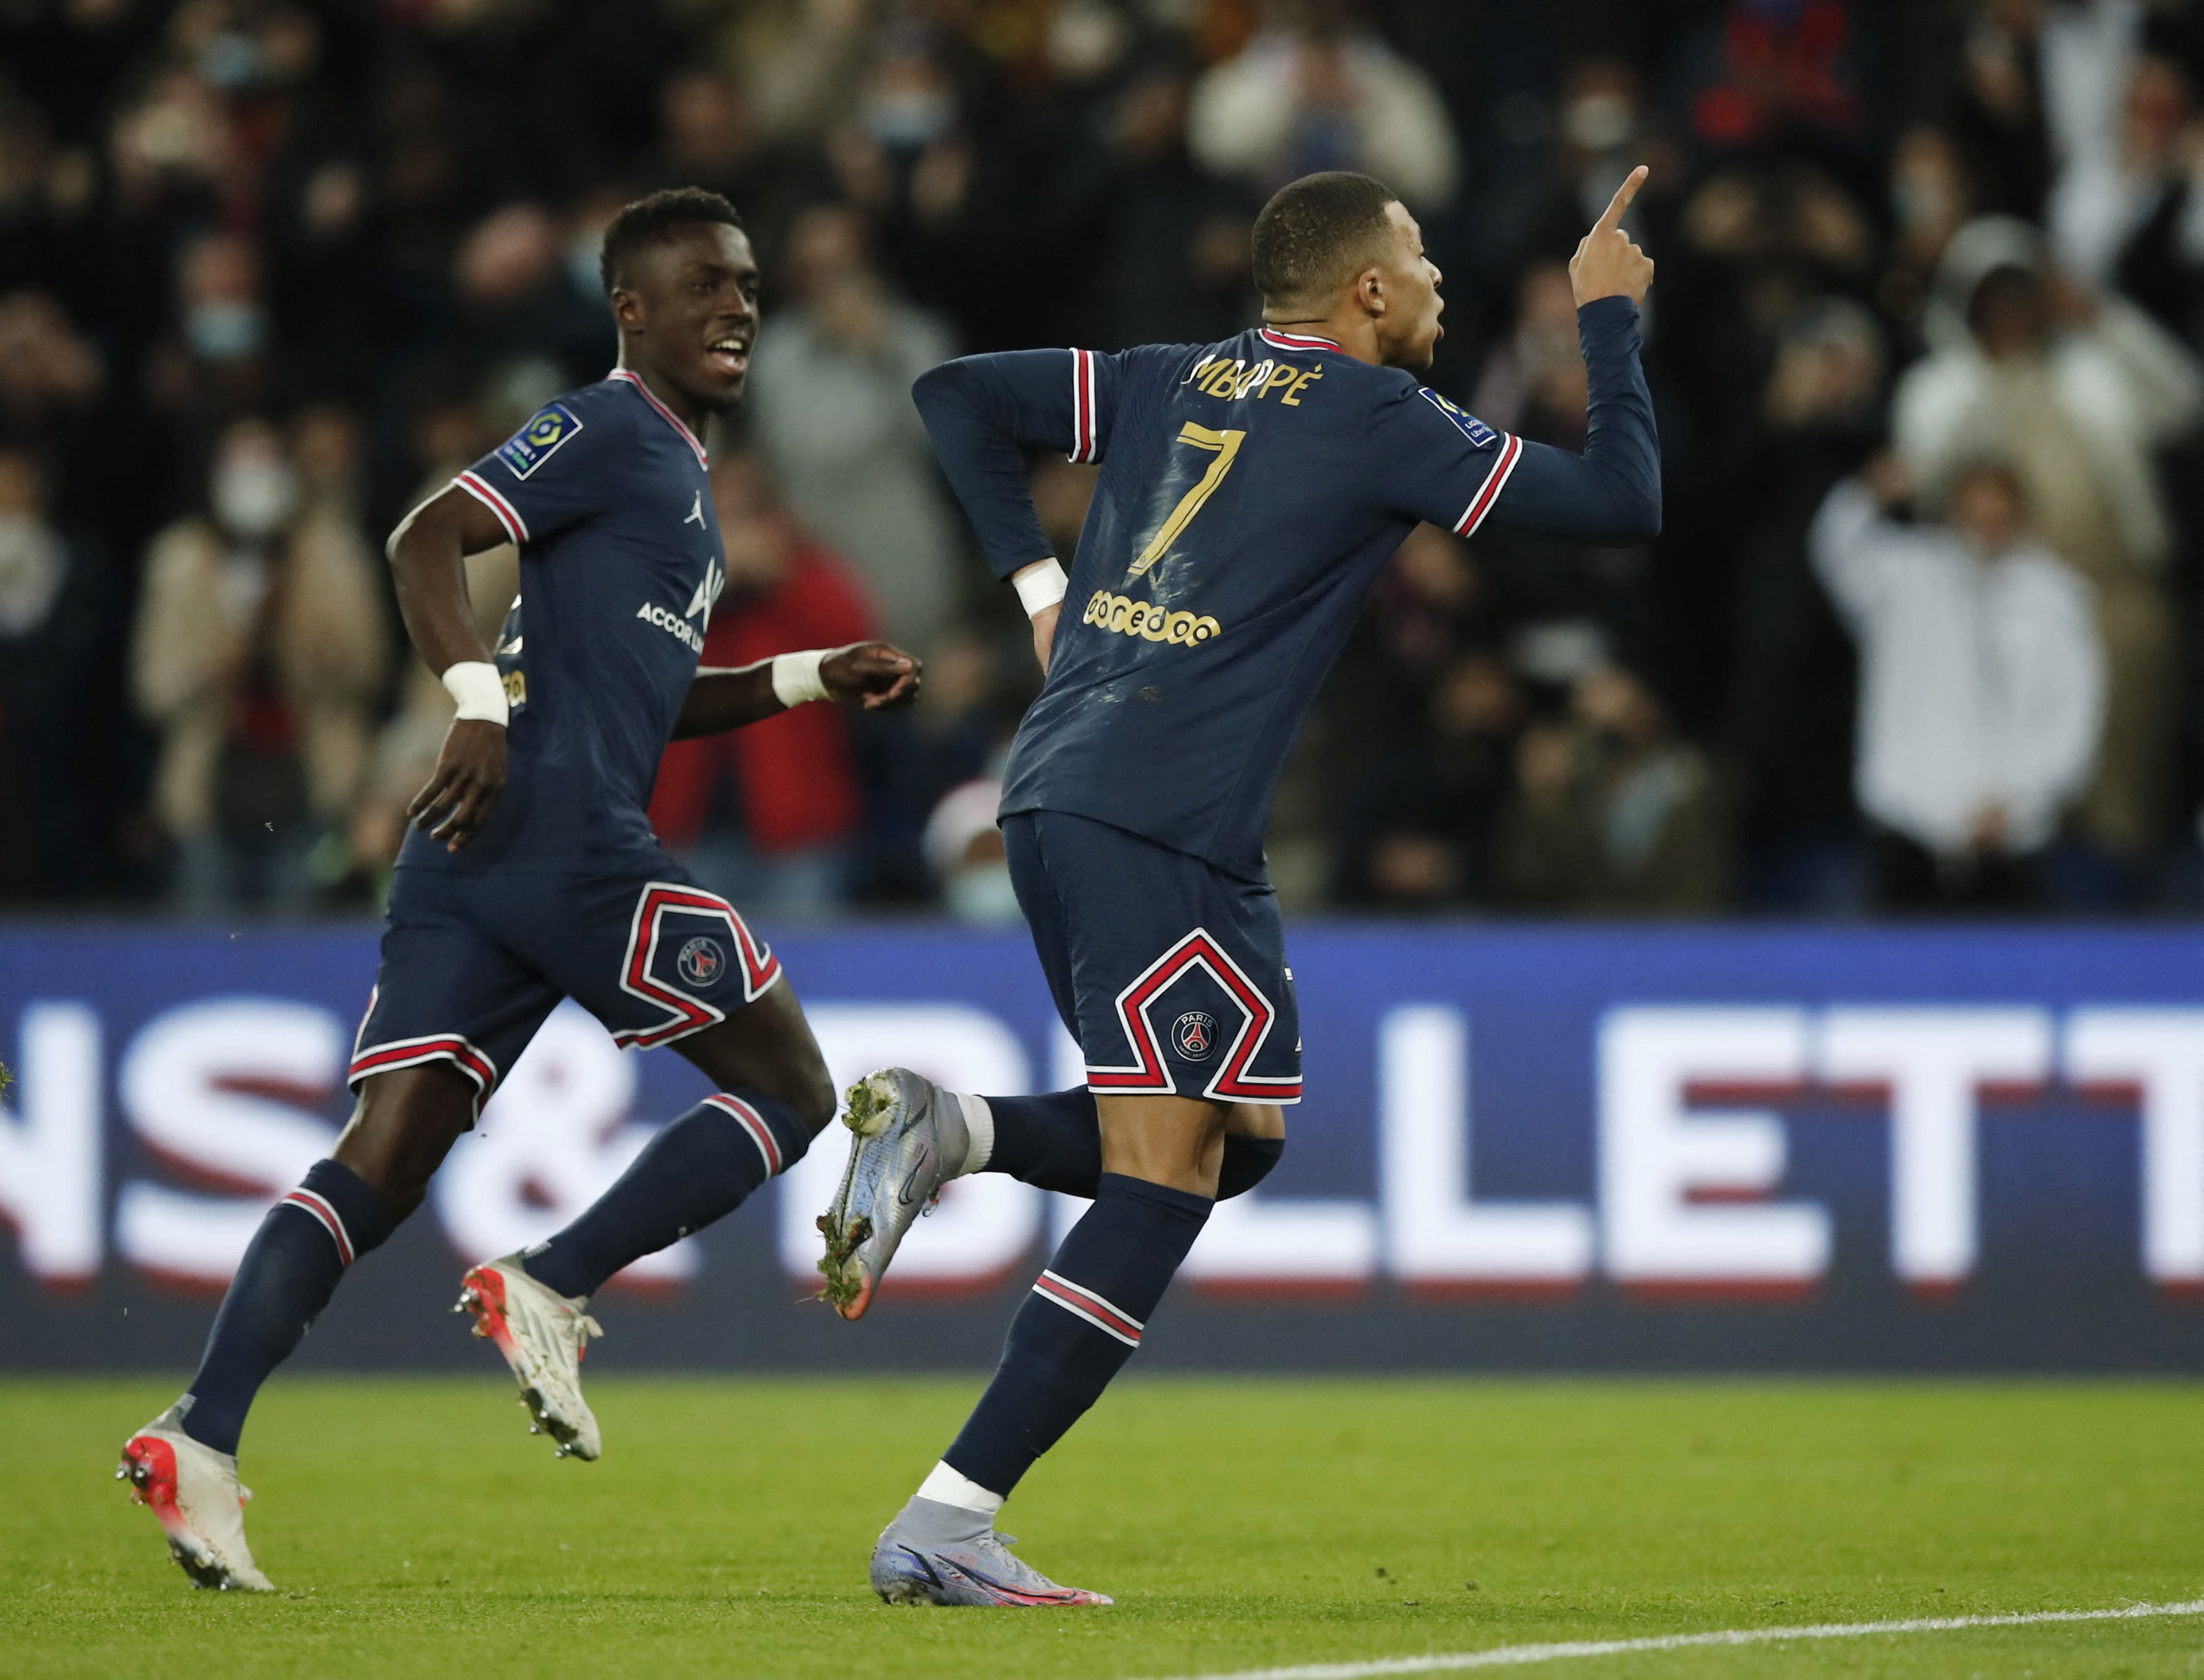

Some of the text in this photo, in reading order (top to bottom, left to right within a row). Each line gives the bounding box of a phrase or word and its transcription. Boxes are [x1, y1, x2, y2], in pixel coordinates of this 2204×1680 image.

[1180, 354, 1323, 406] MBAPPÉ
[1127, 421, 1247, 575] 7
[636, 601, 691, 646] ACCOR
[1083, 590, 1221, 647] ooredoo
[1181, 1014, 1214, 1028] PARIS
[778, 999, 2204, 1298] BLETT
